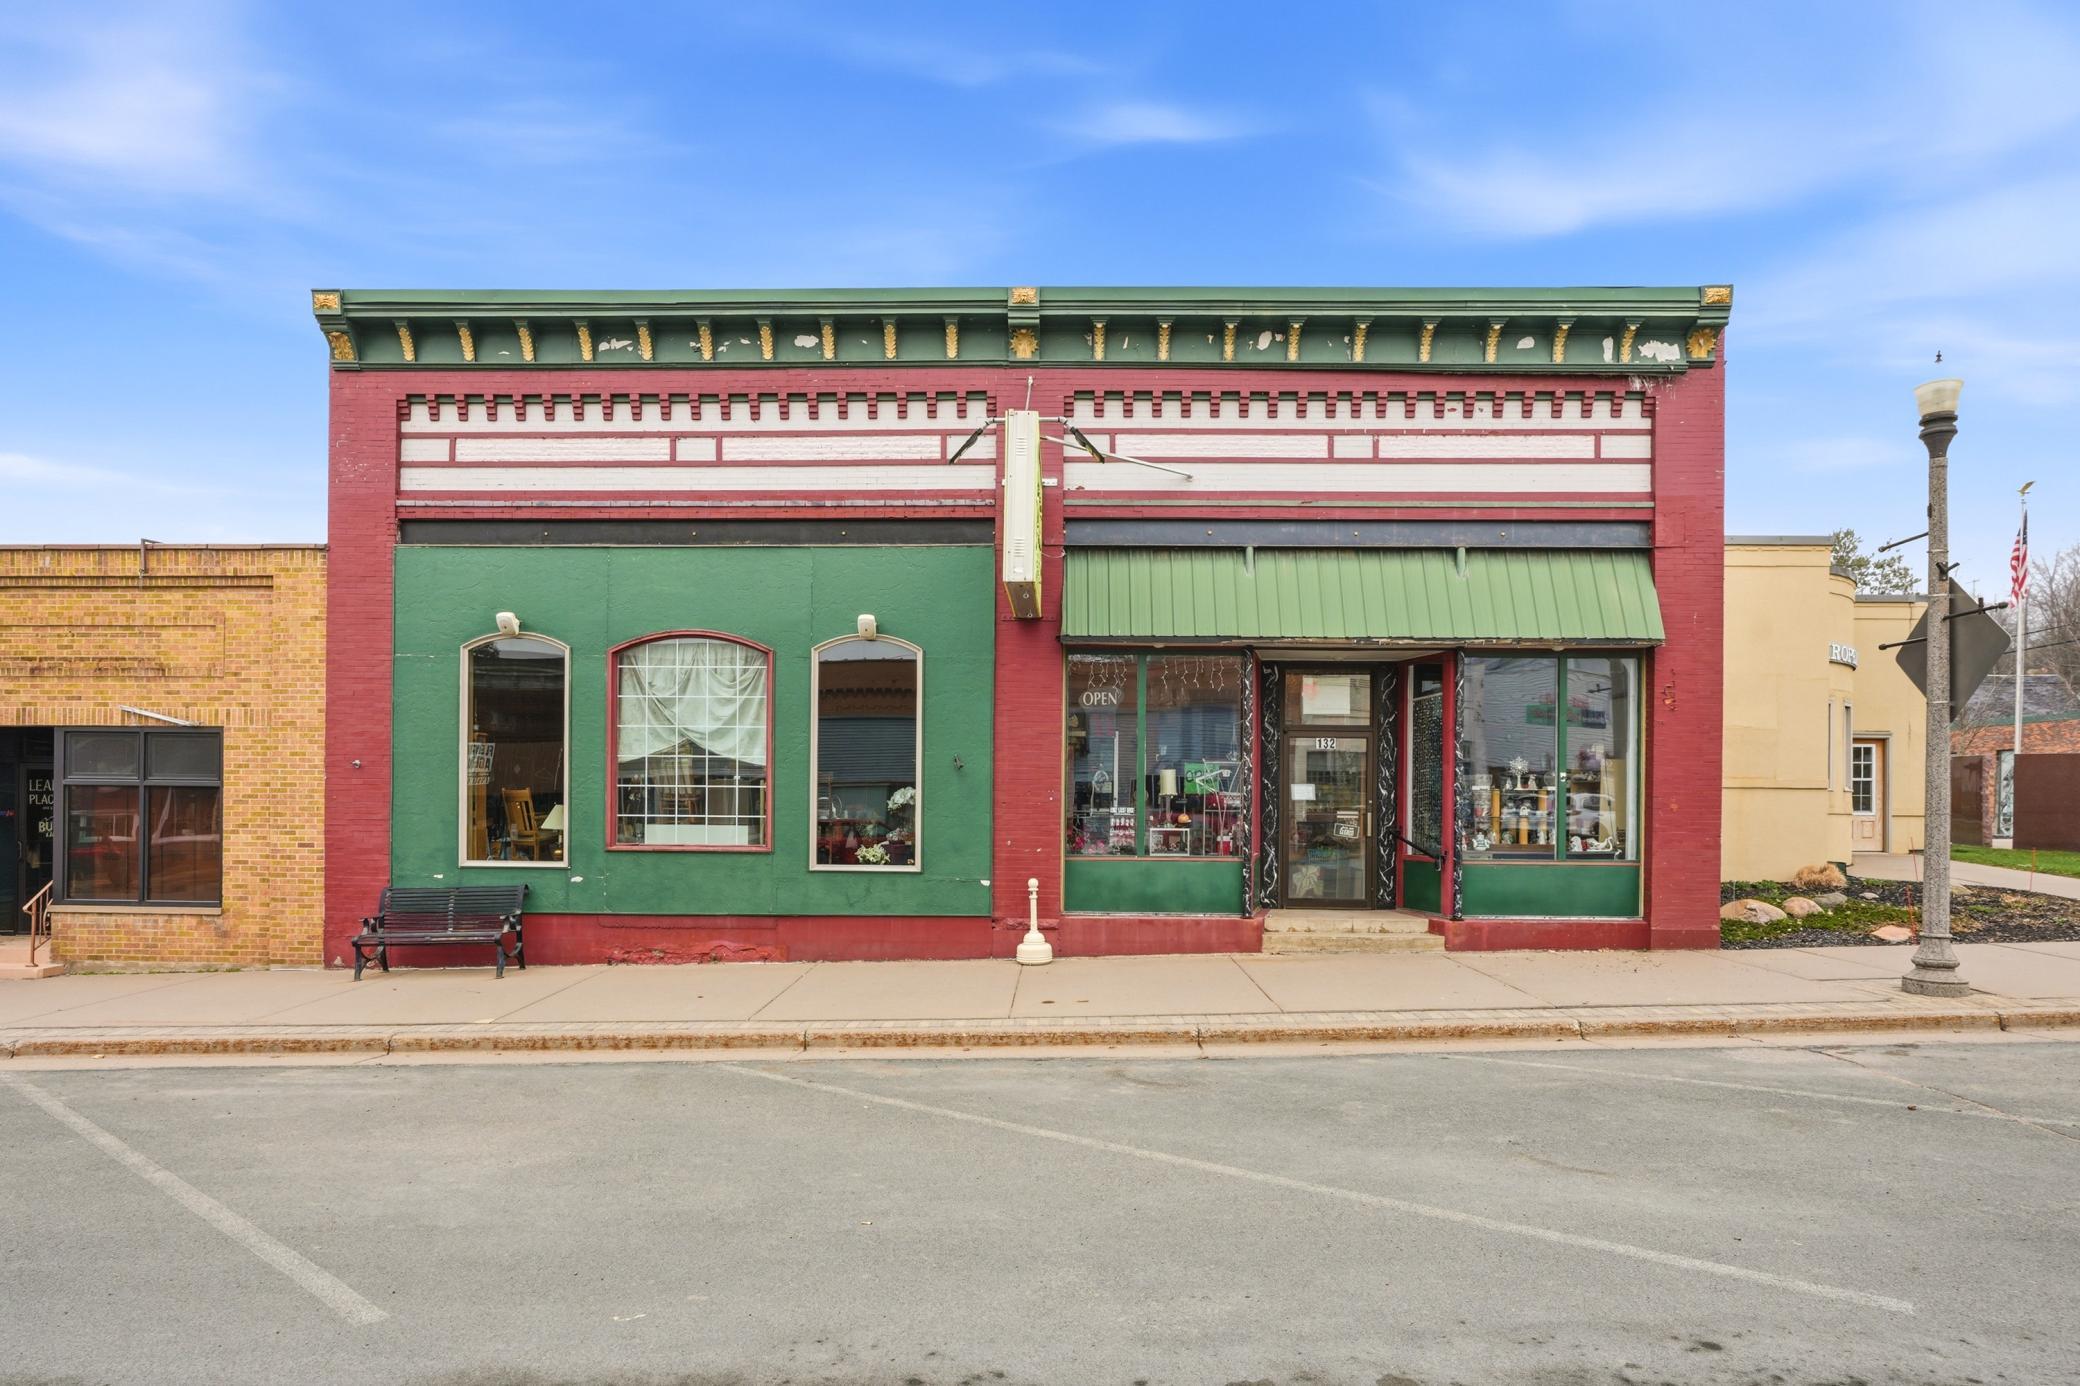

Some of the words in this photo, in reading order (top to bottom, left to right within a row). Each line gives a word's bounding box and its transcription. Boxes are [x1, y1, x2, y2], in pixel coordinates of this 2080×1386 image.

[1083, 691, 1117, 706] OPEN
[1317, 738, 1335, 749] 132
[29, 779, 54, 791] LEA
